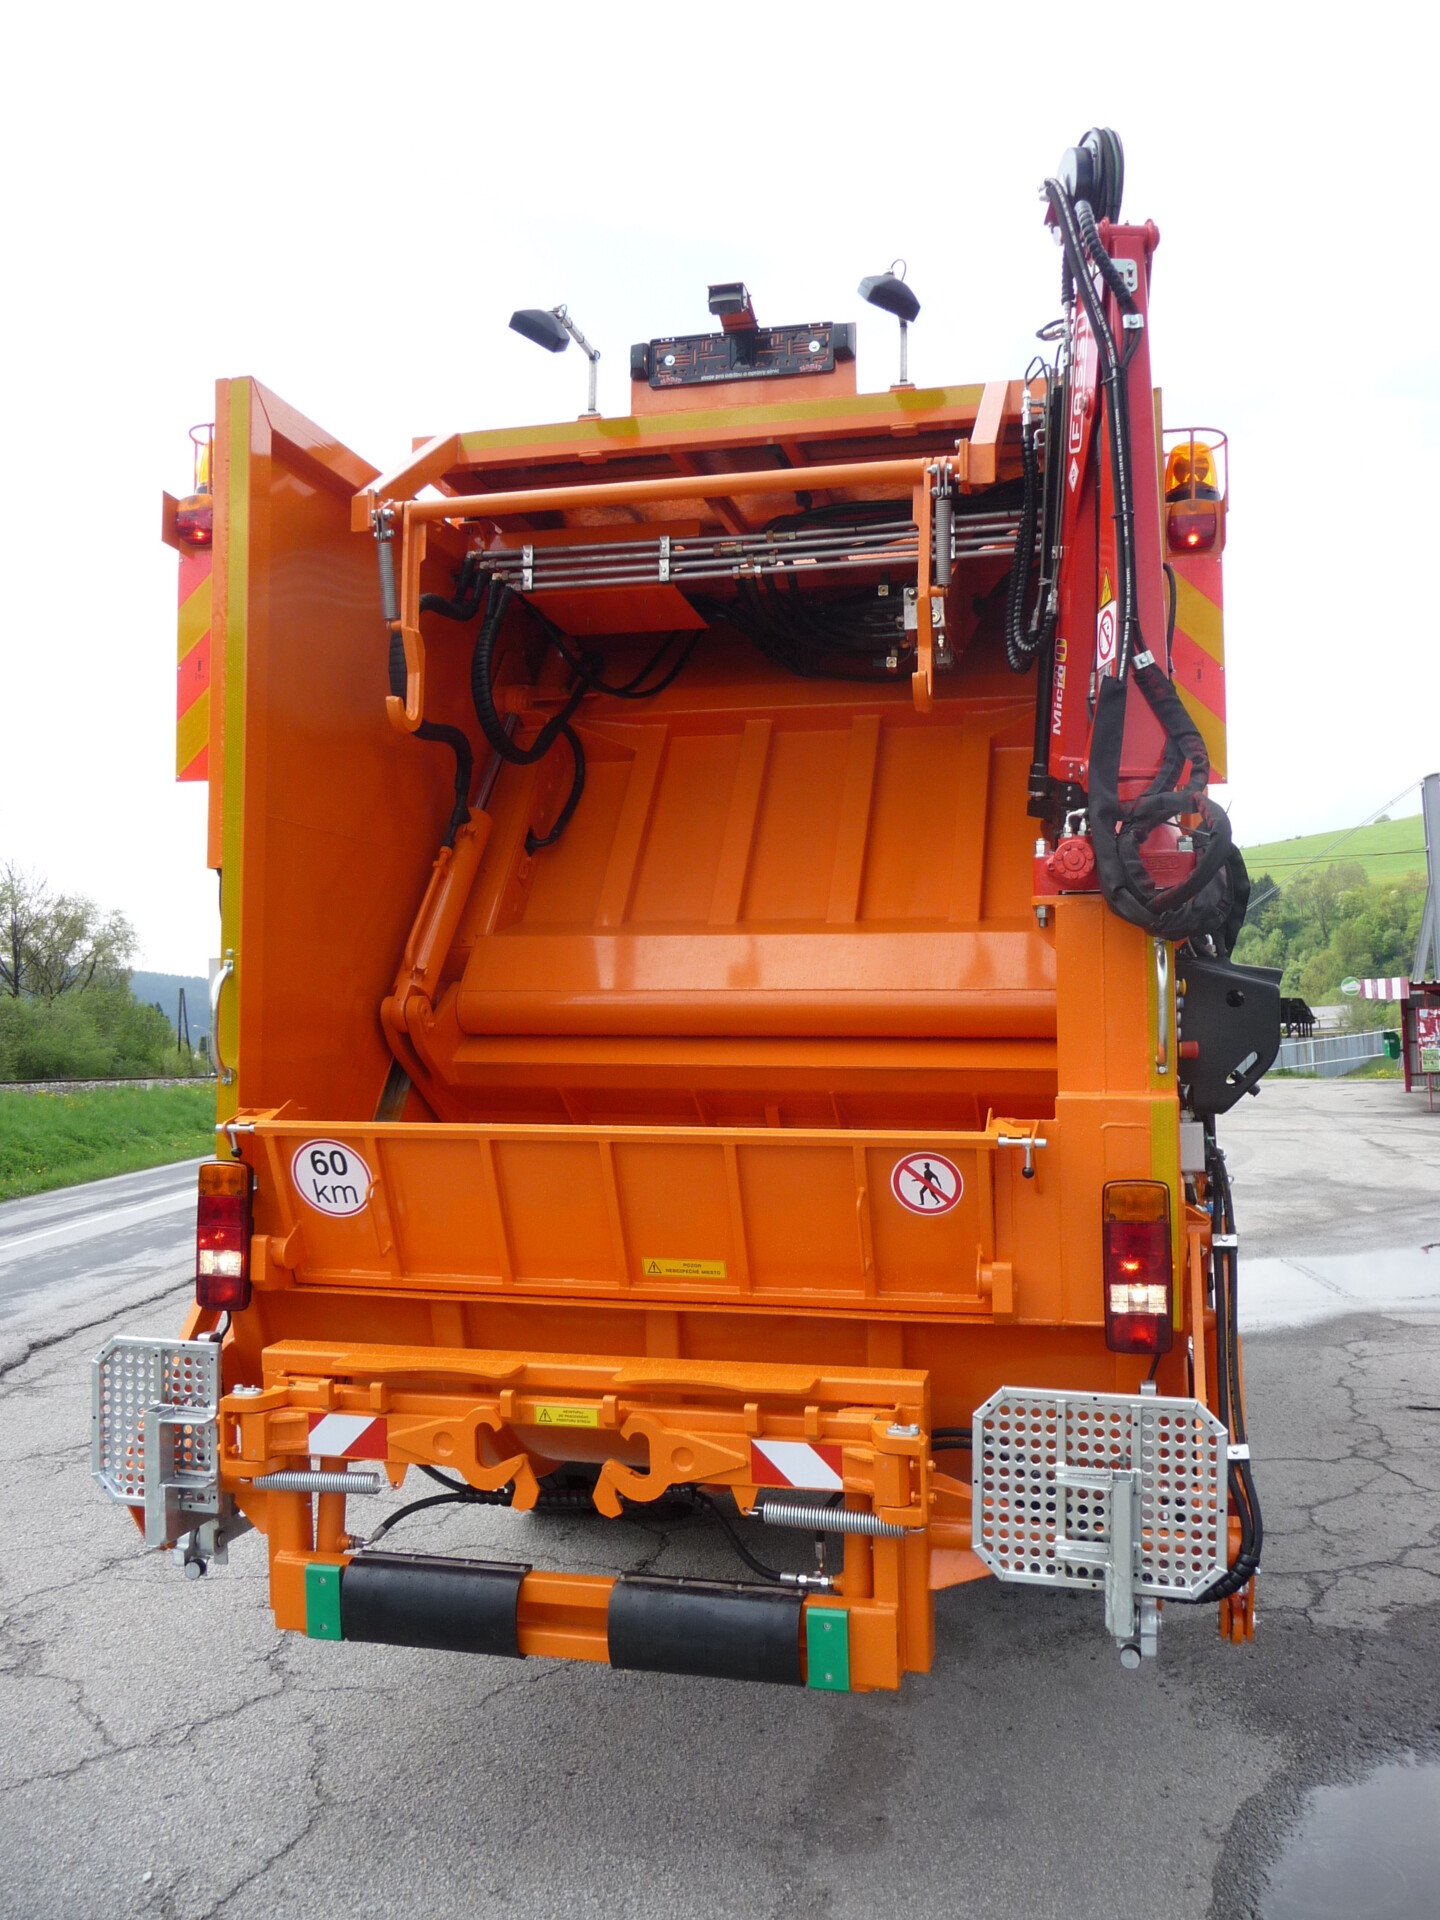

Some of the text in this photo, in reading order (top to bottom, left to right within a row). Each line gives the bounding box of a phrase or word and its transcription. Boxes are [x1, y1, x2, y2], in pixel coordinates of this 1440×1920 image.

[1070, 322, 1086, 441] FASSI
[1051, 665, 1065, 736] Micro
[310, 1150, 348, 1176] 60
[312, 1178, 359, 1204] km
